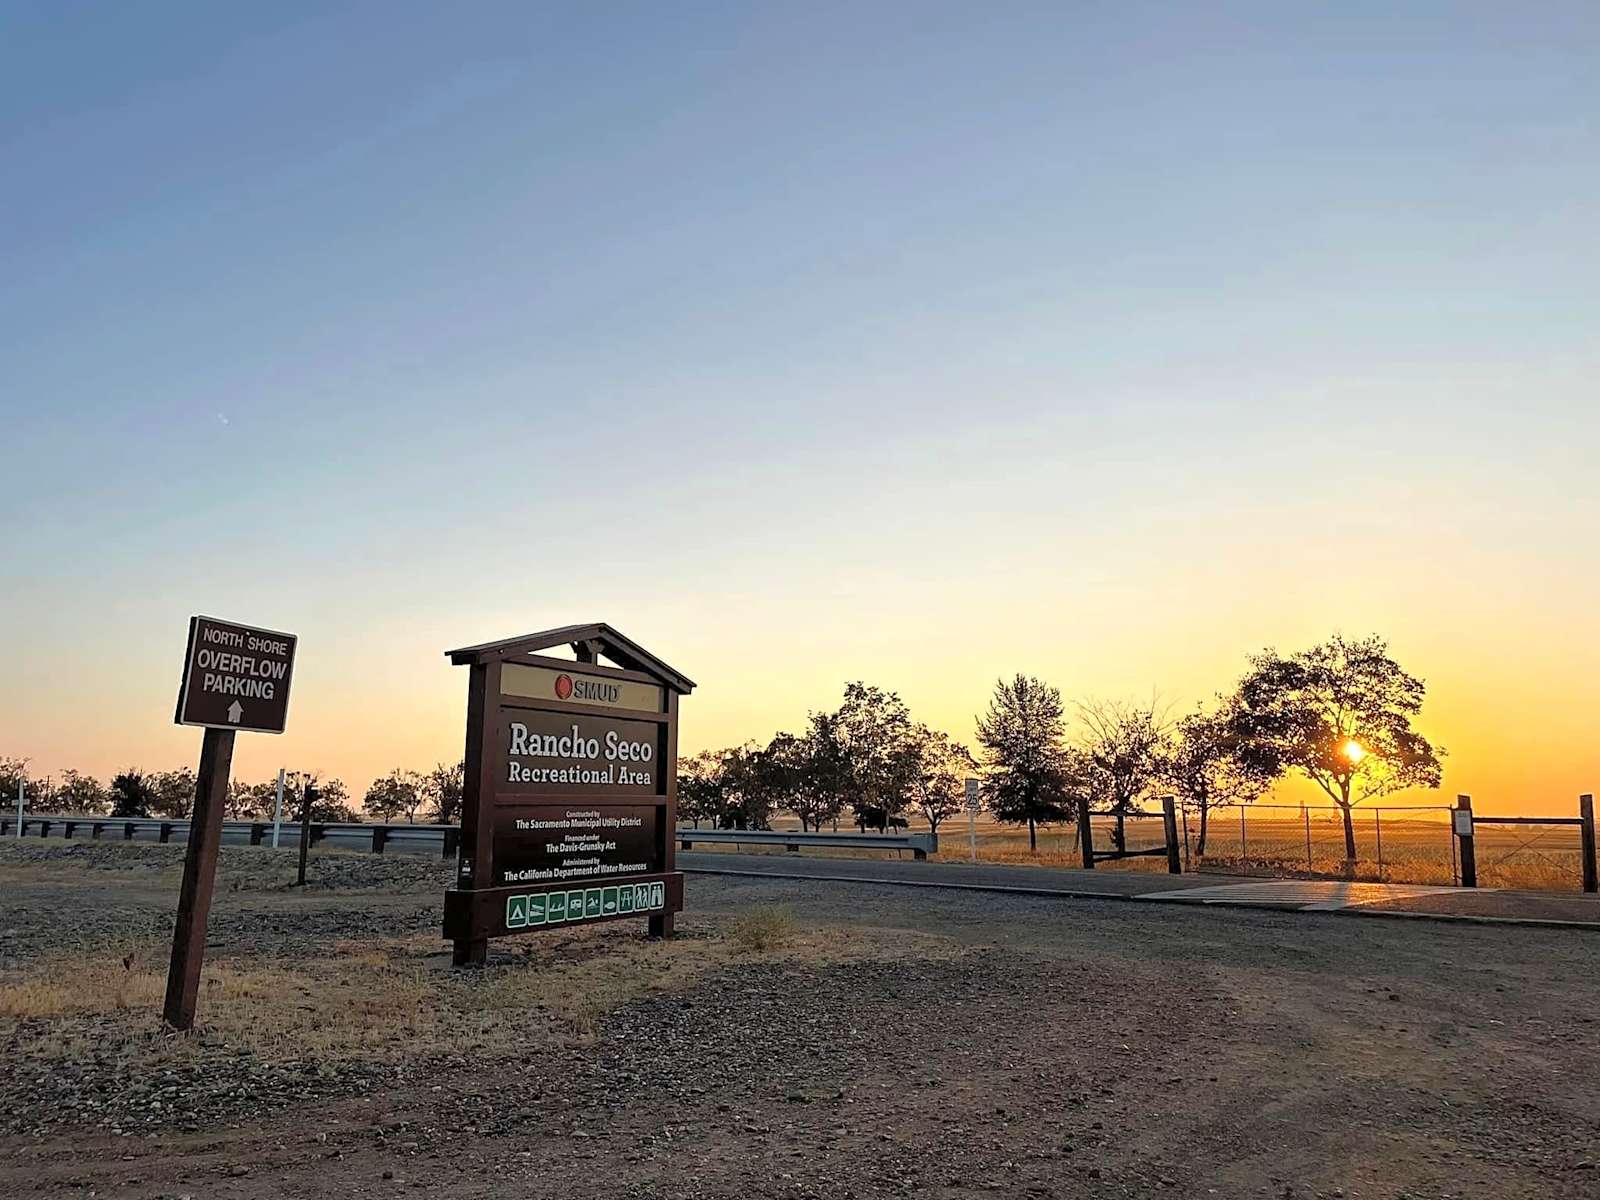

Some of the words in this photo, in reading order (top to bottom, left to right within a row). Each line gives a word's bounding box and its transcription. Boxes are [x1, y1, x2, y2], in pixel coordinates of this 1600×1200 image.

[203, 628, 244, 648] NORTH
[247, 636, 288, 656] SHORE
[197, 649, 287, 679] OVERFLOW
[203, 673, 274, 700] PARKING
[574, 680, 618, 703] SMUD
[510, 722, 599, 759] Rancho
[605, 730, 652, 762] Seco
[508, 761, 614, 784] Recreational
[618, 766, 651, 785] Area
[967, 793, 978, 805] 25
[516, 819, 530, 830] The
[530, 818, 571, 829] Sacramento
[571, 818, 602, 829] Municipal
[602, 817, 621, 828] Utility
[621, 817, 642, 827] District
[566, 810, 592, 818] Constructed
[593, 810, 601, 819] by
[546, 843, 559, 853] The
[559, 842, 605, 853] Davis-Grunsky
[605, 841, 616, 850] Act
[564, 834, 586, 842] Financed
[504, 871, 518, 882] The
[519, 868, 553, 880] California
[553, 866, 593, 879] Department
[593, 865, 601, 874] of
[600, 864, 618, 873] Water
[618, 862, 647, 872] Resources
